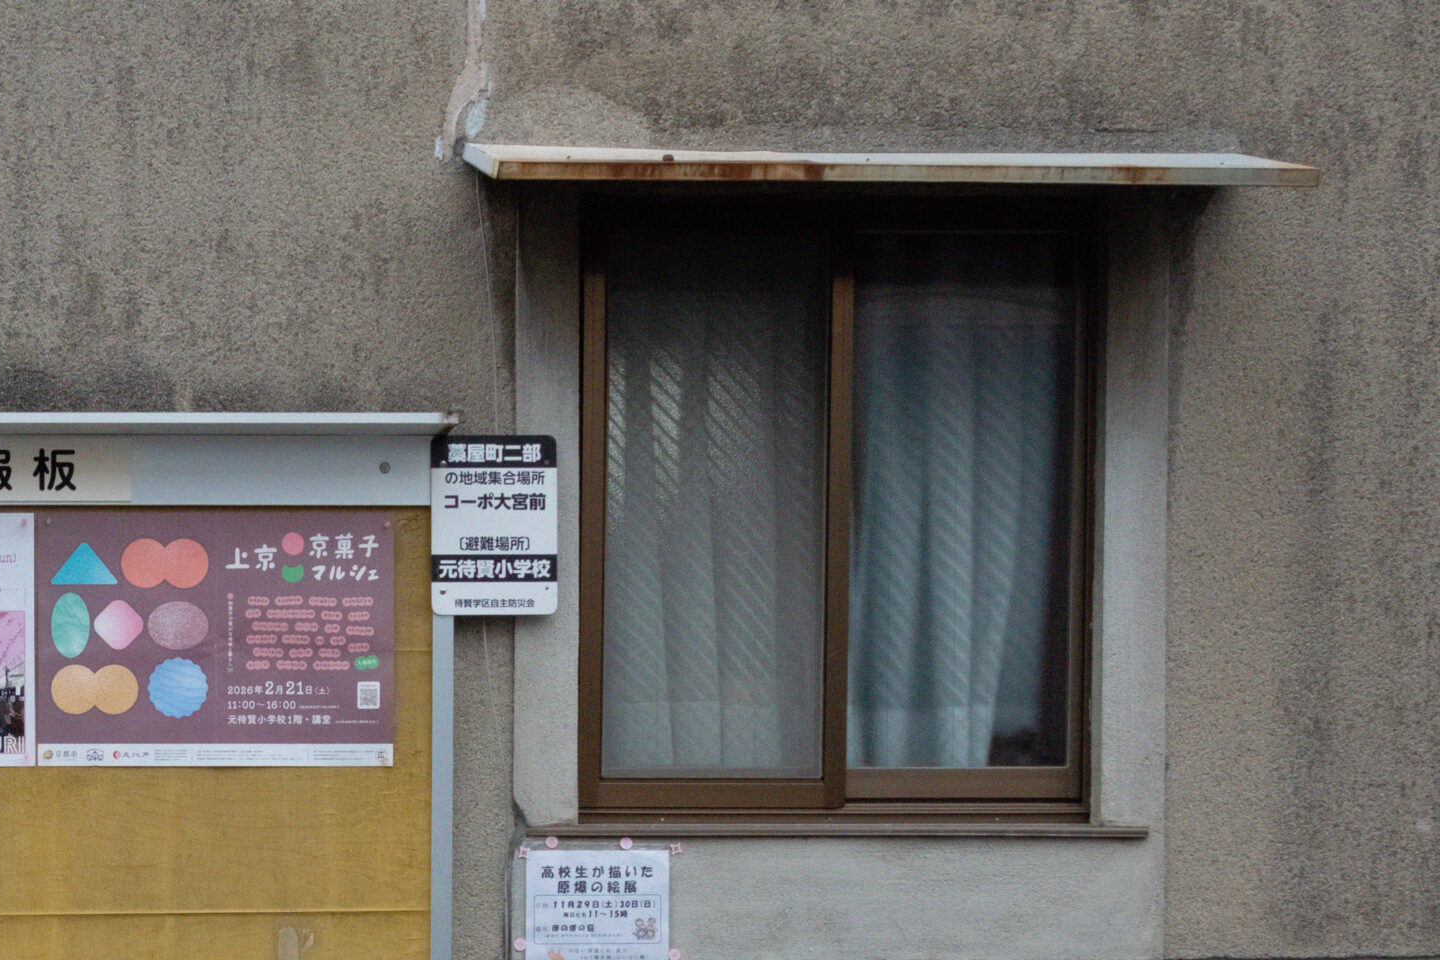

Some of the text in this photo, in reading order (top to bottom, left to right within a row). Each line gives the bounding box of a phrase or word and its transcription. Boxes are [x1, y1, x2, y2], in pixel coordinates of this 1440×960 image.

[445, 471, 545, 485] の地域集合場所
[444, 493, 546, 510] コーポ大宮前
[309, 533, 379, 560] 京菓子
[225, 544, 277, 571] 上京
[312, 564, 379, 582] マルシェ
[439, 559, 551, 579] 元待賢小学校
[454, 598, 535, 608] 待賢学区自主防災会
[541, 865, 654, 879] 高校生が描いた
[557, 880, 637, 894] 原爆の絵展
